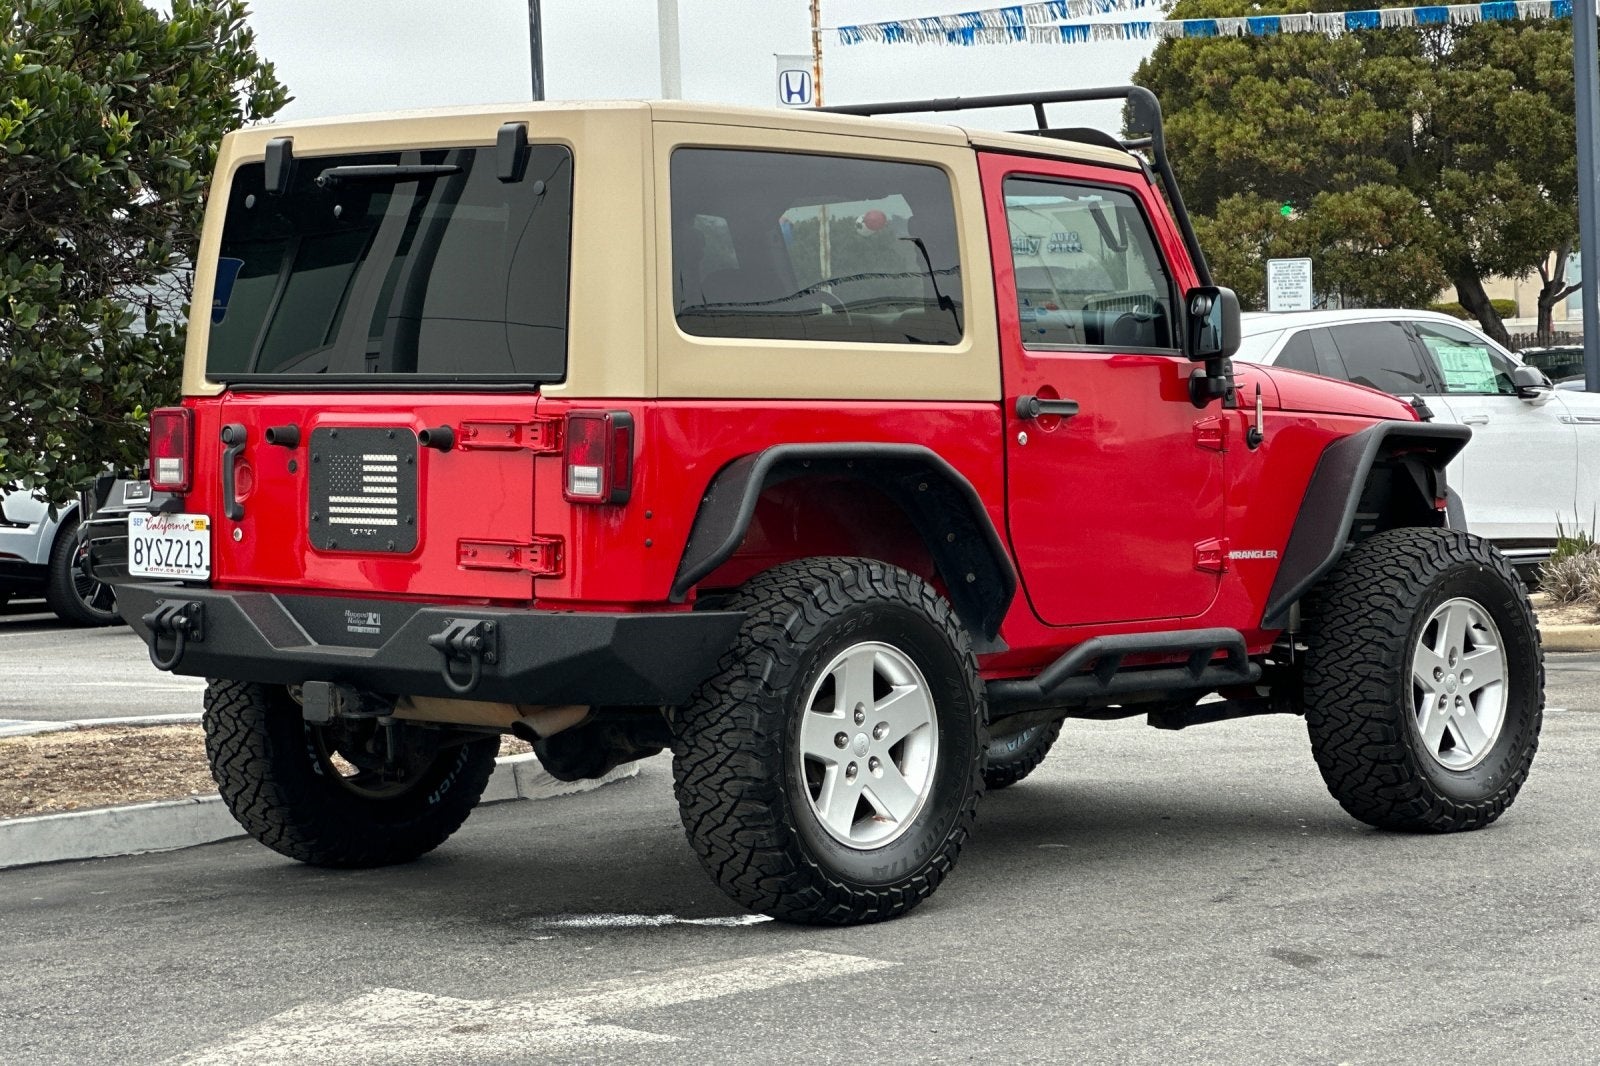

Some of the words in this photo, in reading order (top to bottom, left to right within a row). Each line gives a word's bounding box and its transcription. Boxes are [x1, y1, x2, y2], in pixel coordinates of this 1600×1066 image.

[1051, 231, 1078, 242] AUTO
[1047, 242, 1082, 253] PARTS
[132, 517, 143, 527] SEP
[146, 516, 191, 535] California
[134, 537, 203, 568] 8YSZ213
[1228, 549, 1278, 560] WRANGLER
[149, 566, 189, 574] dmv.ca.gov
